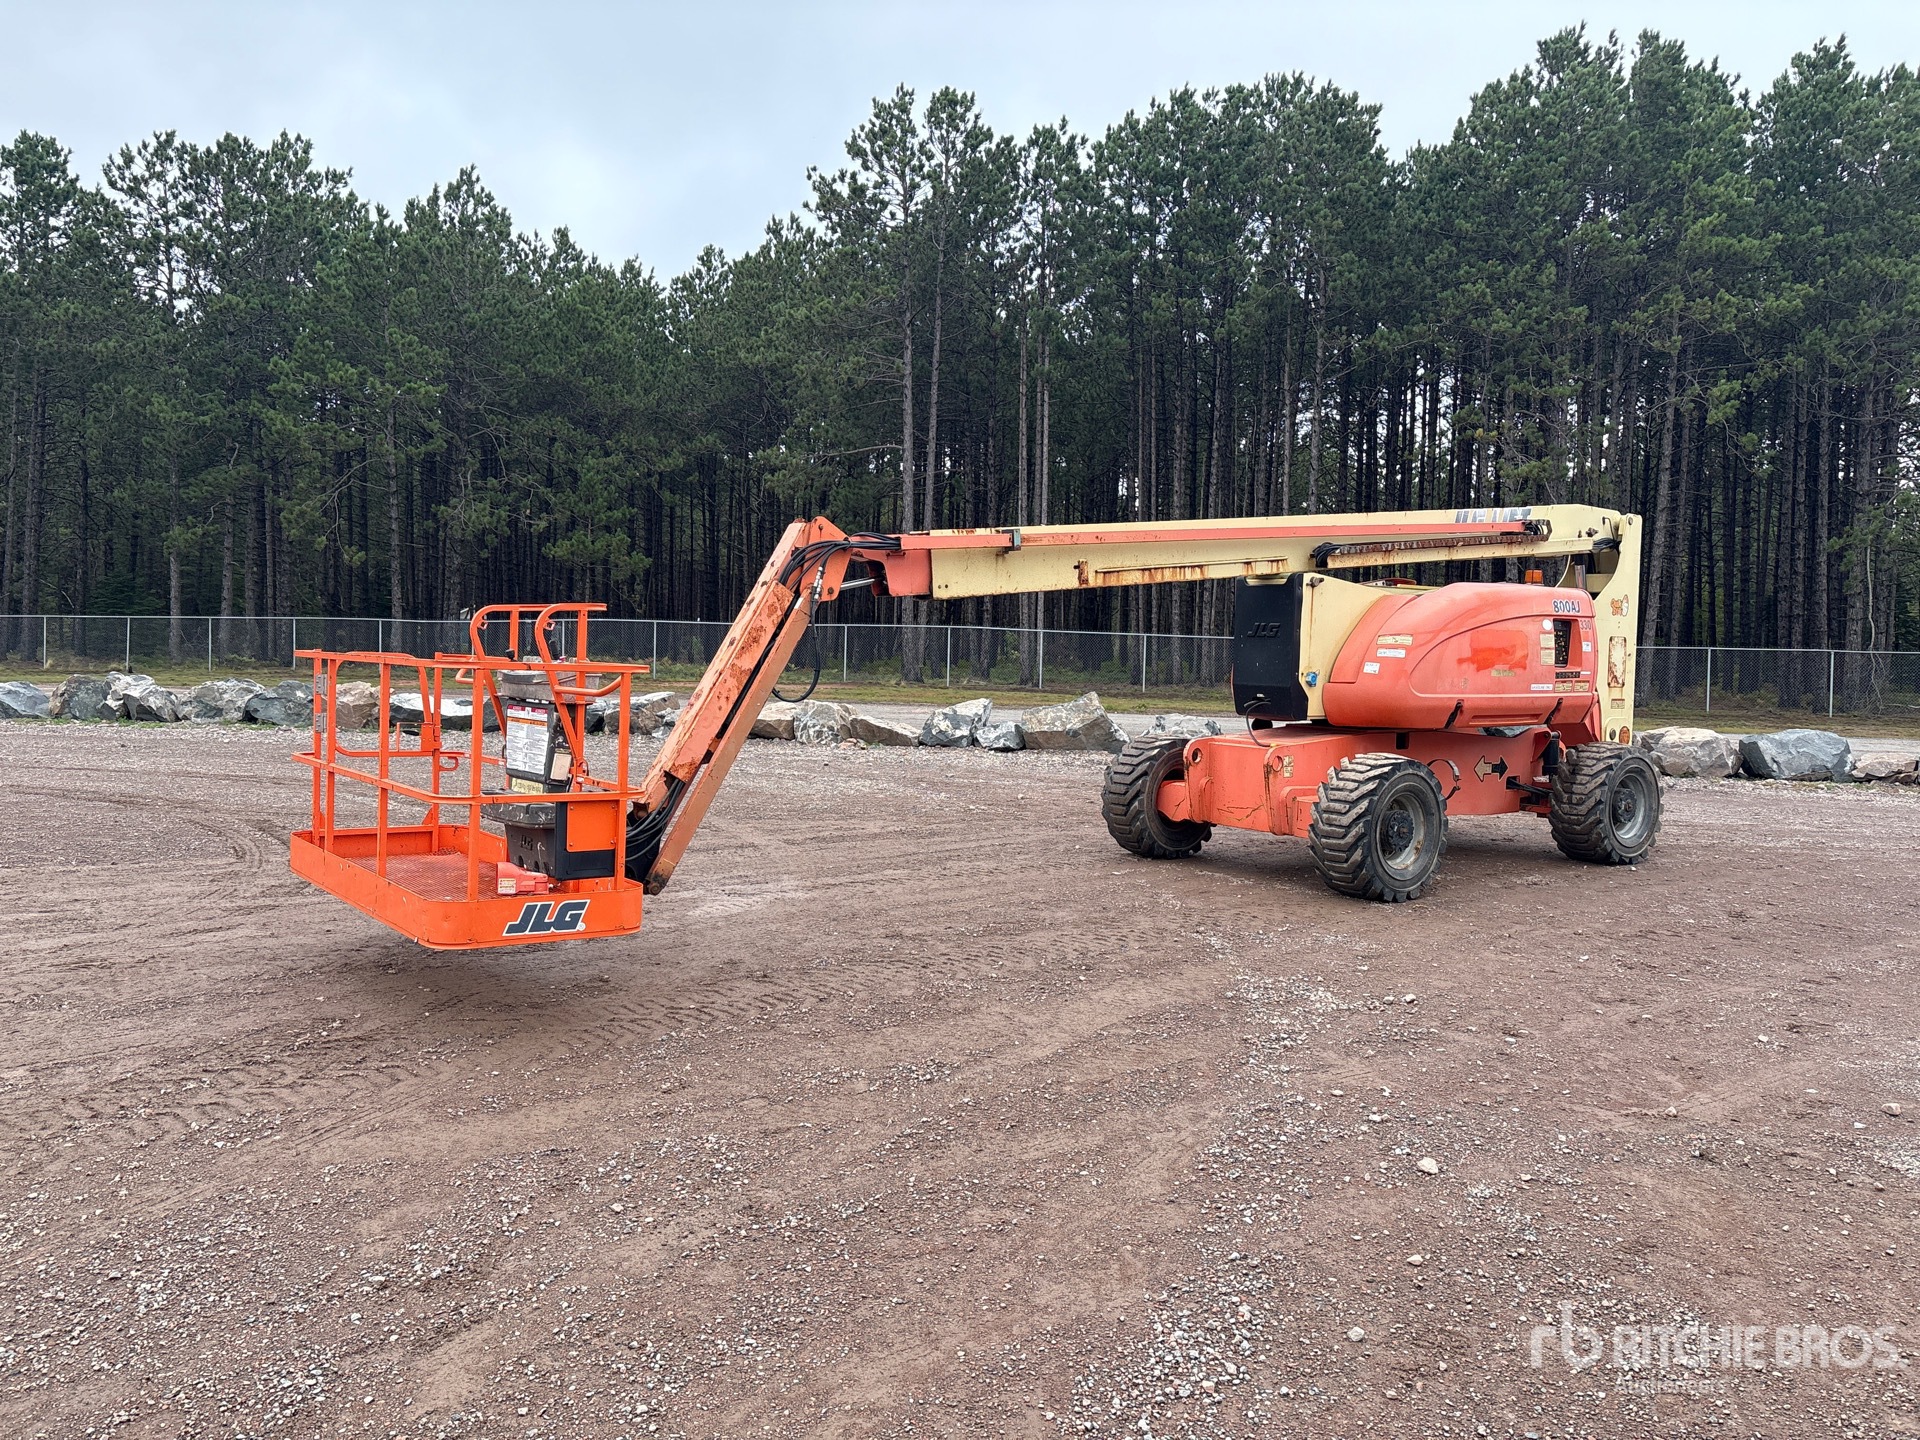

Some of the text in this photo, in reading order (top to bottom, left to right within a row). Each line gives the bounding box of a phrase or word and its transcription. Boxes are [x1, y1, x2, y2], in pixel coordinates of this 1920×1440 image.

[1552, 600, 1581, 614] 800AJ
[1247, 622, 1281, 638] JLG
[1579, 619, 1592, 631] 330
[502, 900, 590, 936] JLG
